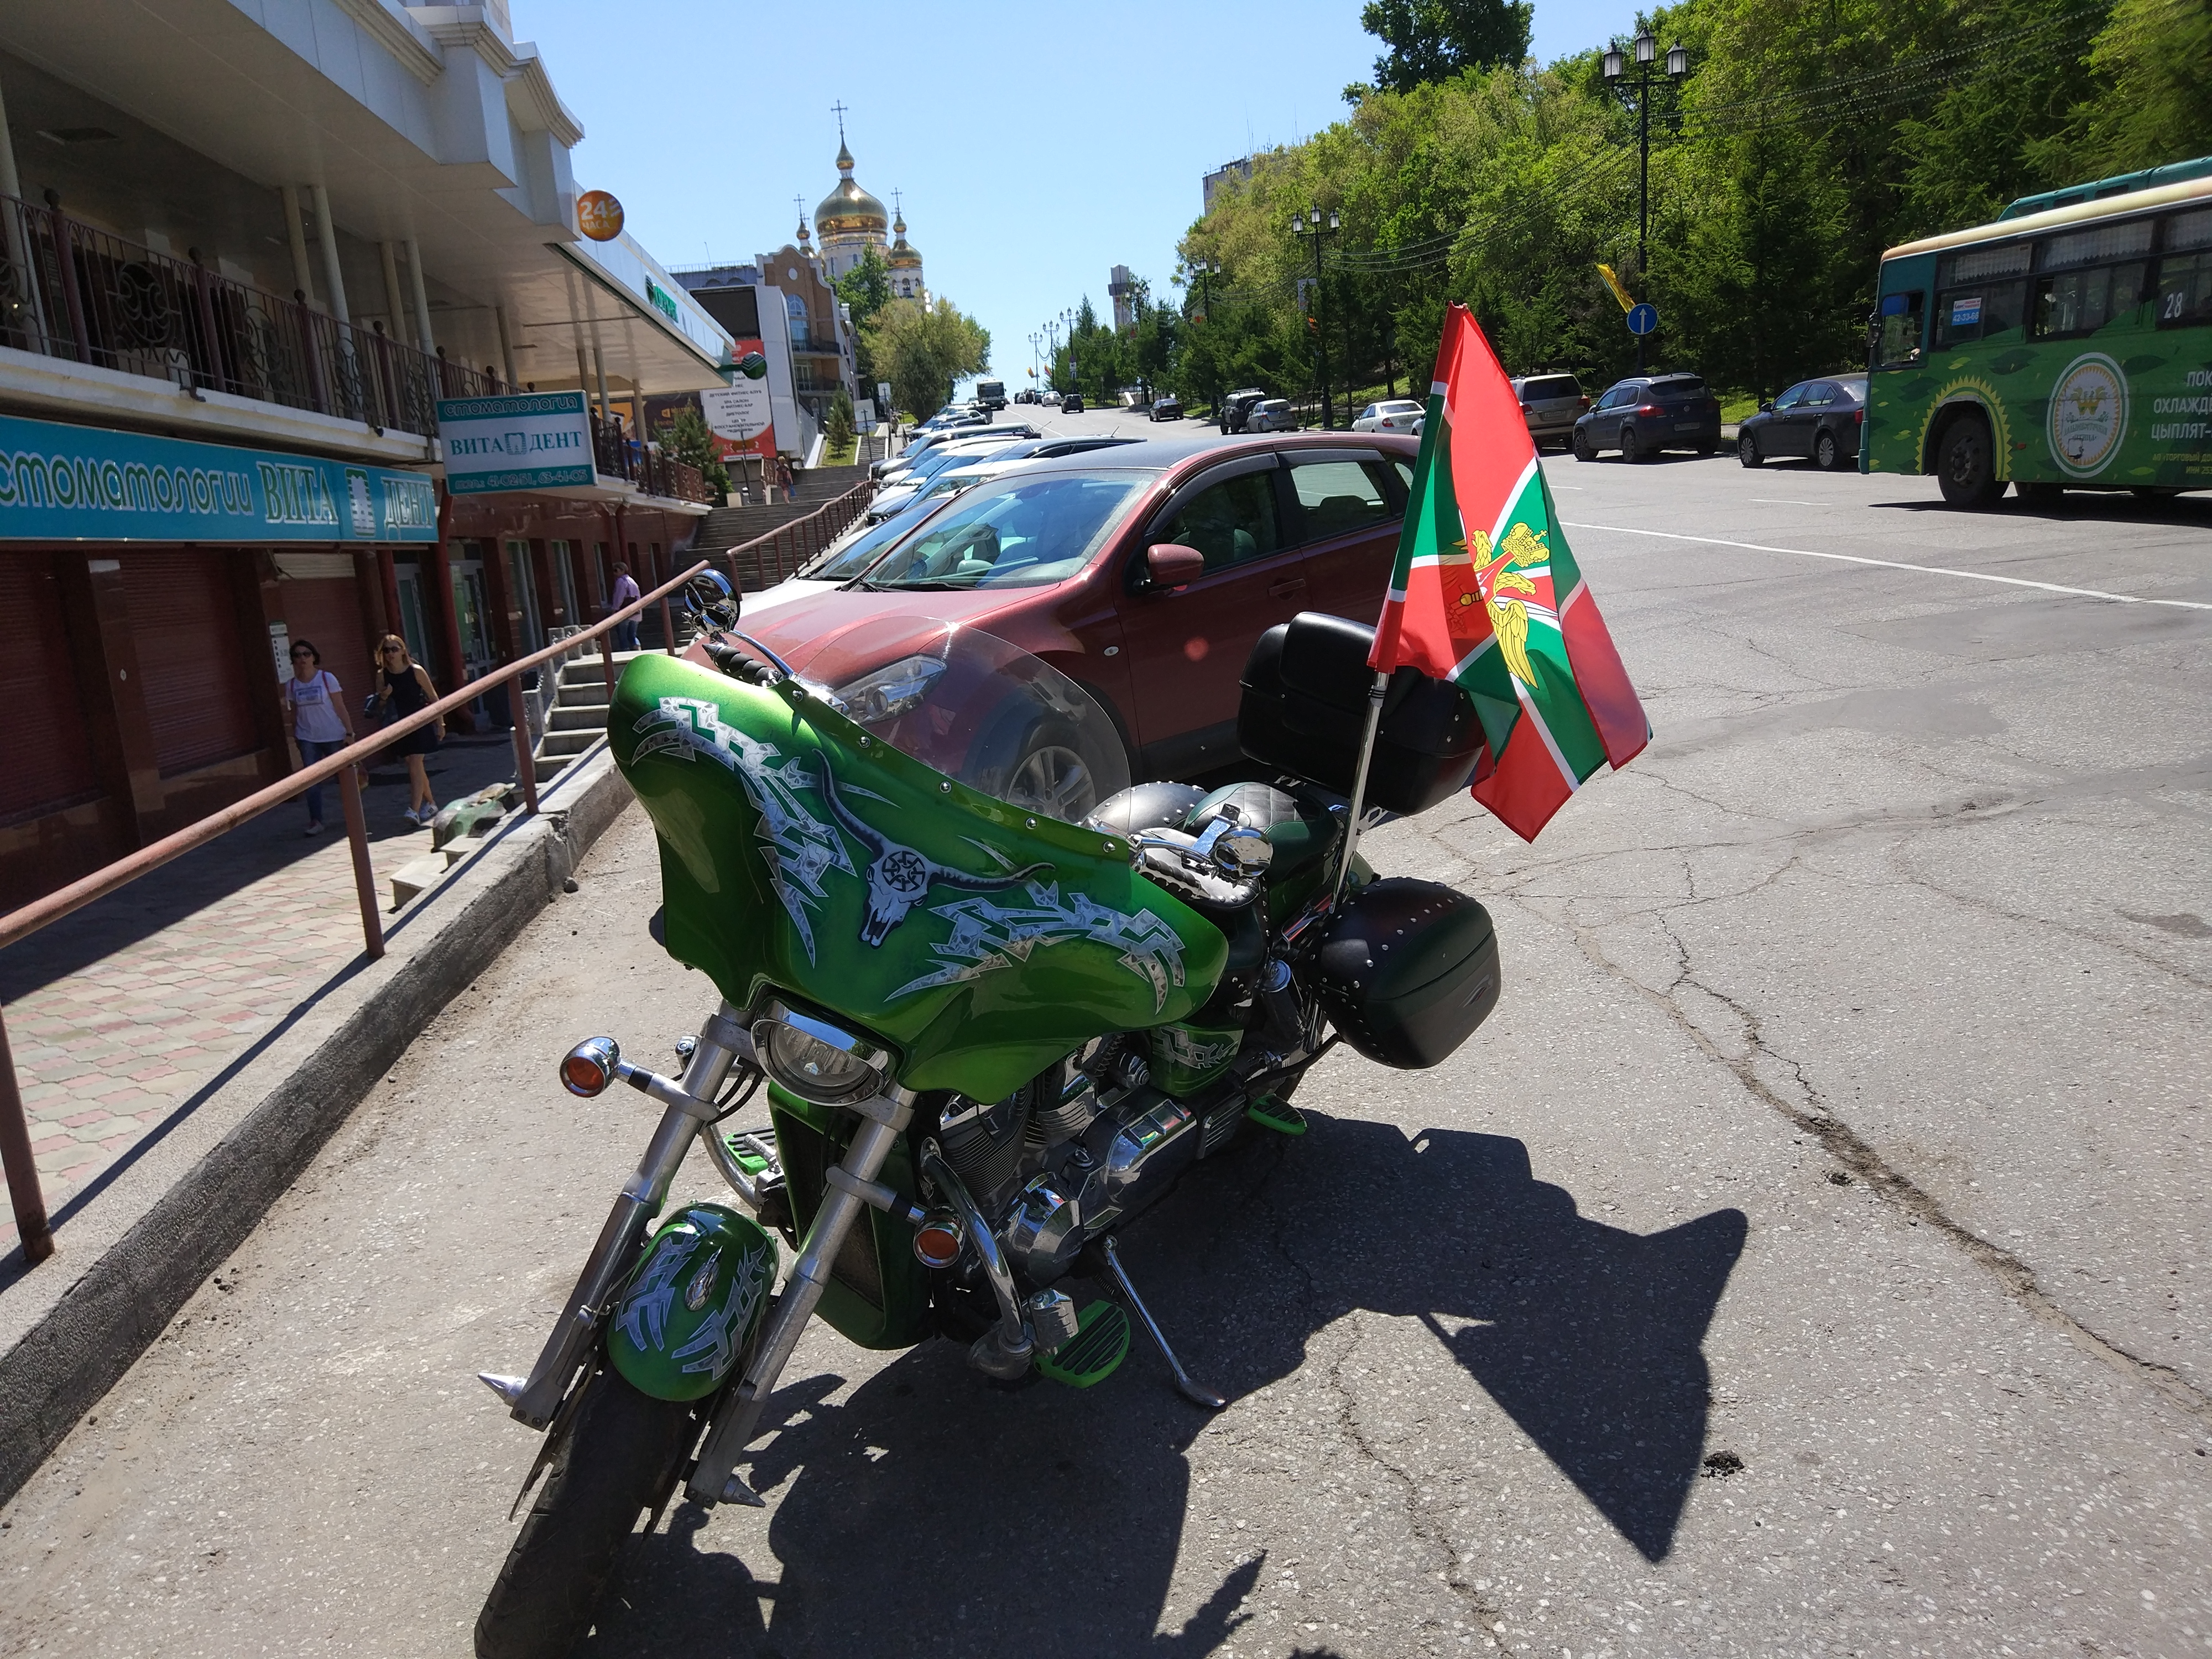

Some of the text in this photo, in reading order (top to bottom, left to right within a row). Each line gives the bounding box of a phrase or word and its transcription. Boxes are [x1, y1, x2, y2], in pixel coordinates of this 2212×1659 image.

[580, 200, 608, 220] 24
[581, 220, 611, 229] ЧАСА
[2163, 292, 2183, 319] 28
[2151, 422, 2212, 441] ЦЫПЛЯТ-
[450, 431, 582, 455] ВИТА ДЕНТ
[256, 461, 338, 525] ВИТА
[380, 476, 434, 540] ДЕНТ
